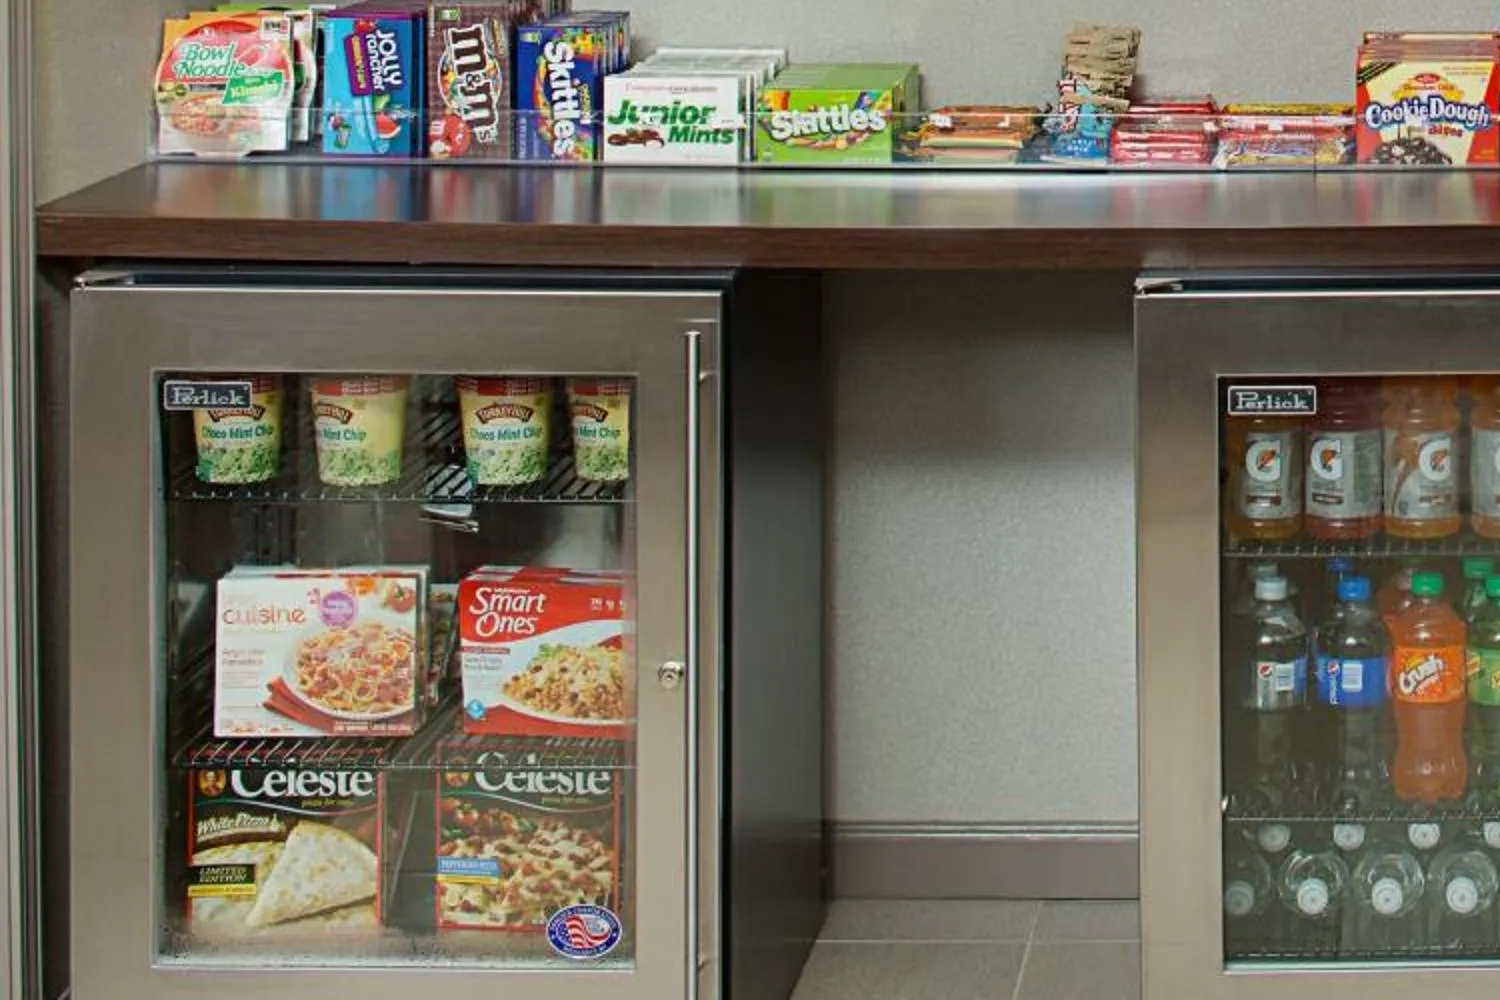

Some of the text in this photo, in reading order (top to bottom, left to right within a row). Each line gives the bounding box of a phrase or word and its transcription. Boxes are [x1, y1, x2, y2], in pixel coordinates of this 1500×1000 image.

[183, 41, 237, 61] Bowl
[365, 33, 385, 91] rancher
[376, 29, 403, 86] JOLLY
[173, 58, 246, 79] Noodle
[543, 41, 581, 158] Skittles
[606, 99, 717, 126] Junior
[667, 126, 734, 145] Mints
[771, 103, 886, 141] Skittles
[172, 386, 245, 405] Perlick
[1235, 390, 1309, 410] Perlick
[1246, 440, 1280, 482] G
[1311, 440, 1342, 481] G
[1419, 438, 1450, 481] G
[223, 605, 305, 625] cuisine
[469, 586, 546, 615] Smart
[475, 611, 539, 638] Ones
[231, 760, 374, 797] Celeste
[474, 752, 611, 795] Celeste
